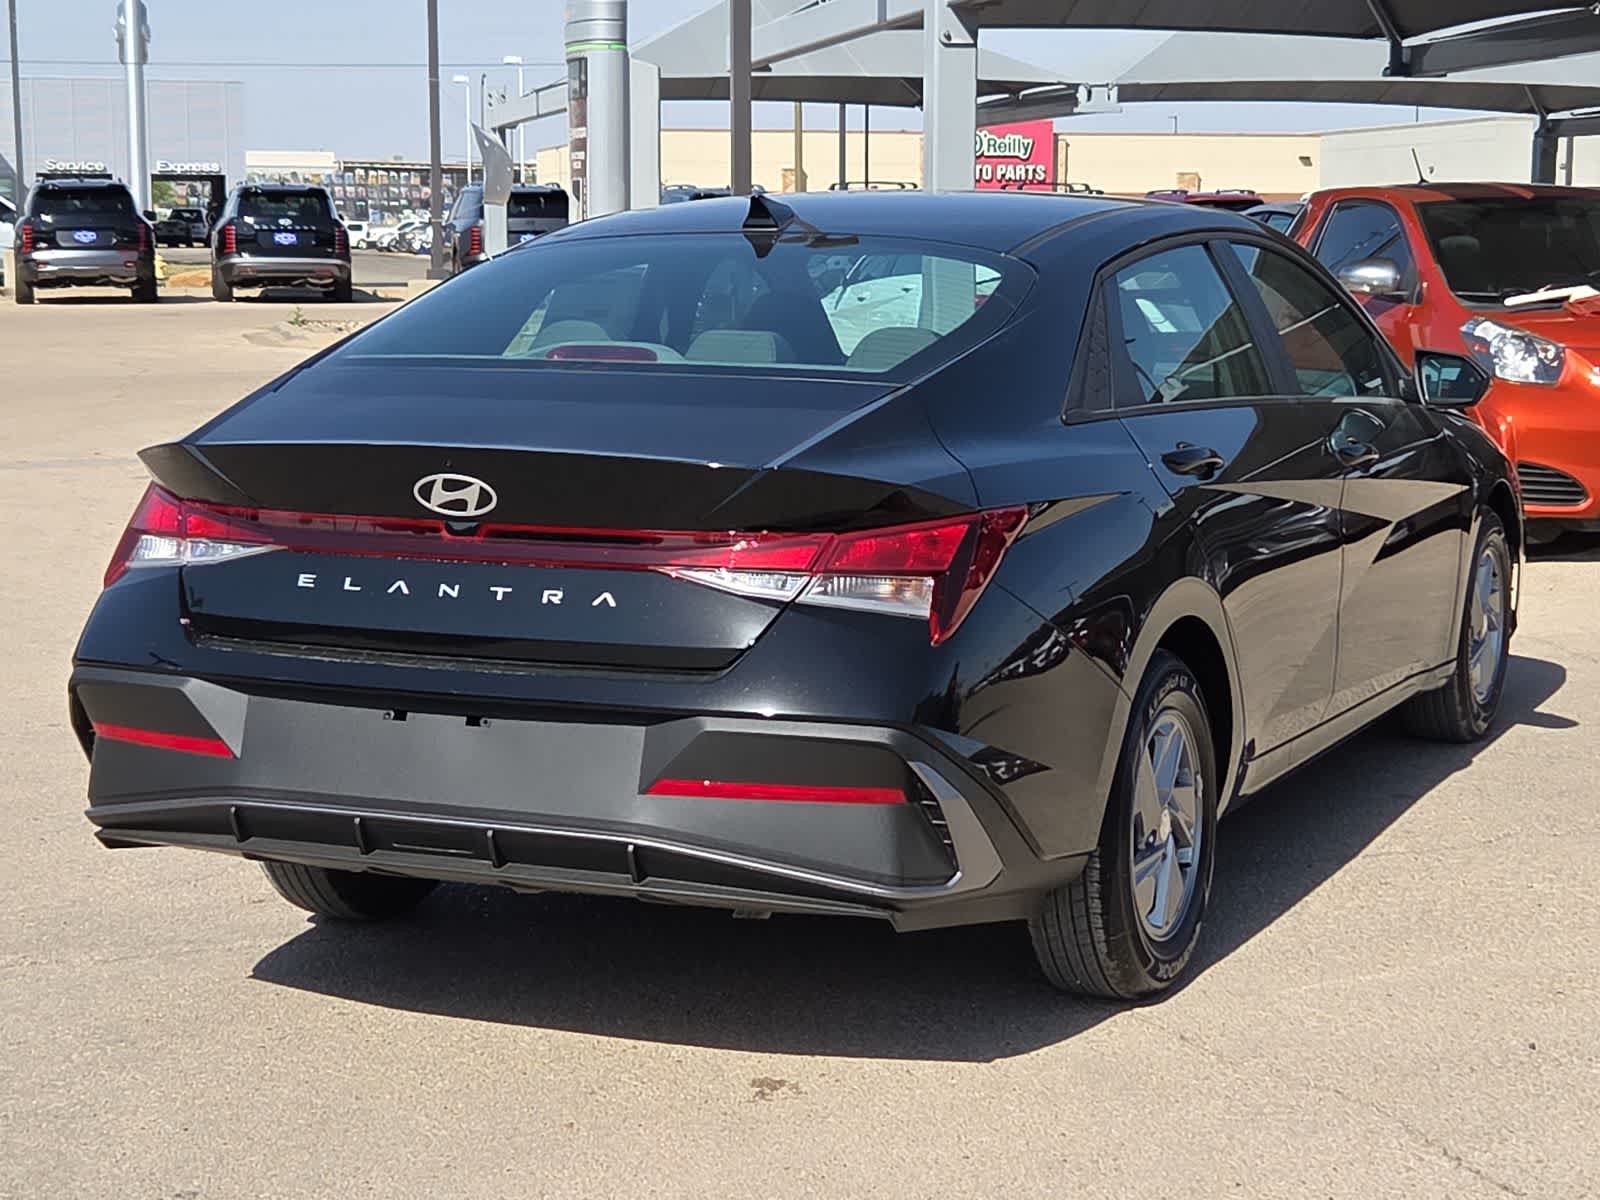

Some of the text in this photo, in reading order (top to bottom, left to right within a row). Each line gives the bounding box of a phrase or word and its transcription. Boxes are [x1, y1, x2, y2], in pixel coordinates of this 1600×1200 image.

[45, 158, 221, 174] Service Express
[996, 164, 1046, 181] PARTS
[297, 572, 617, 608] ELANTRA
